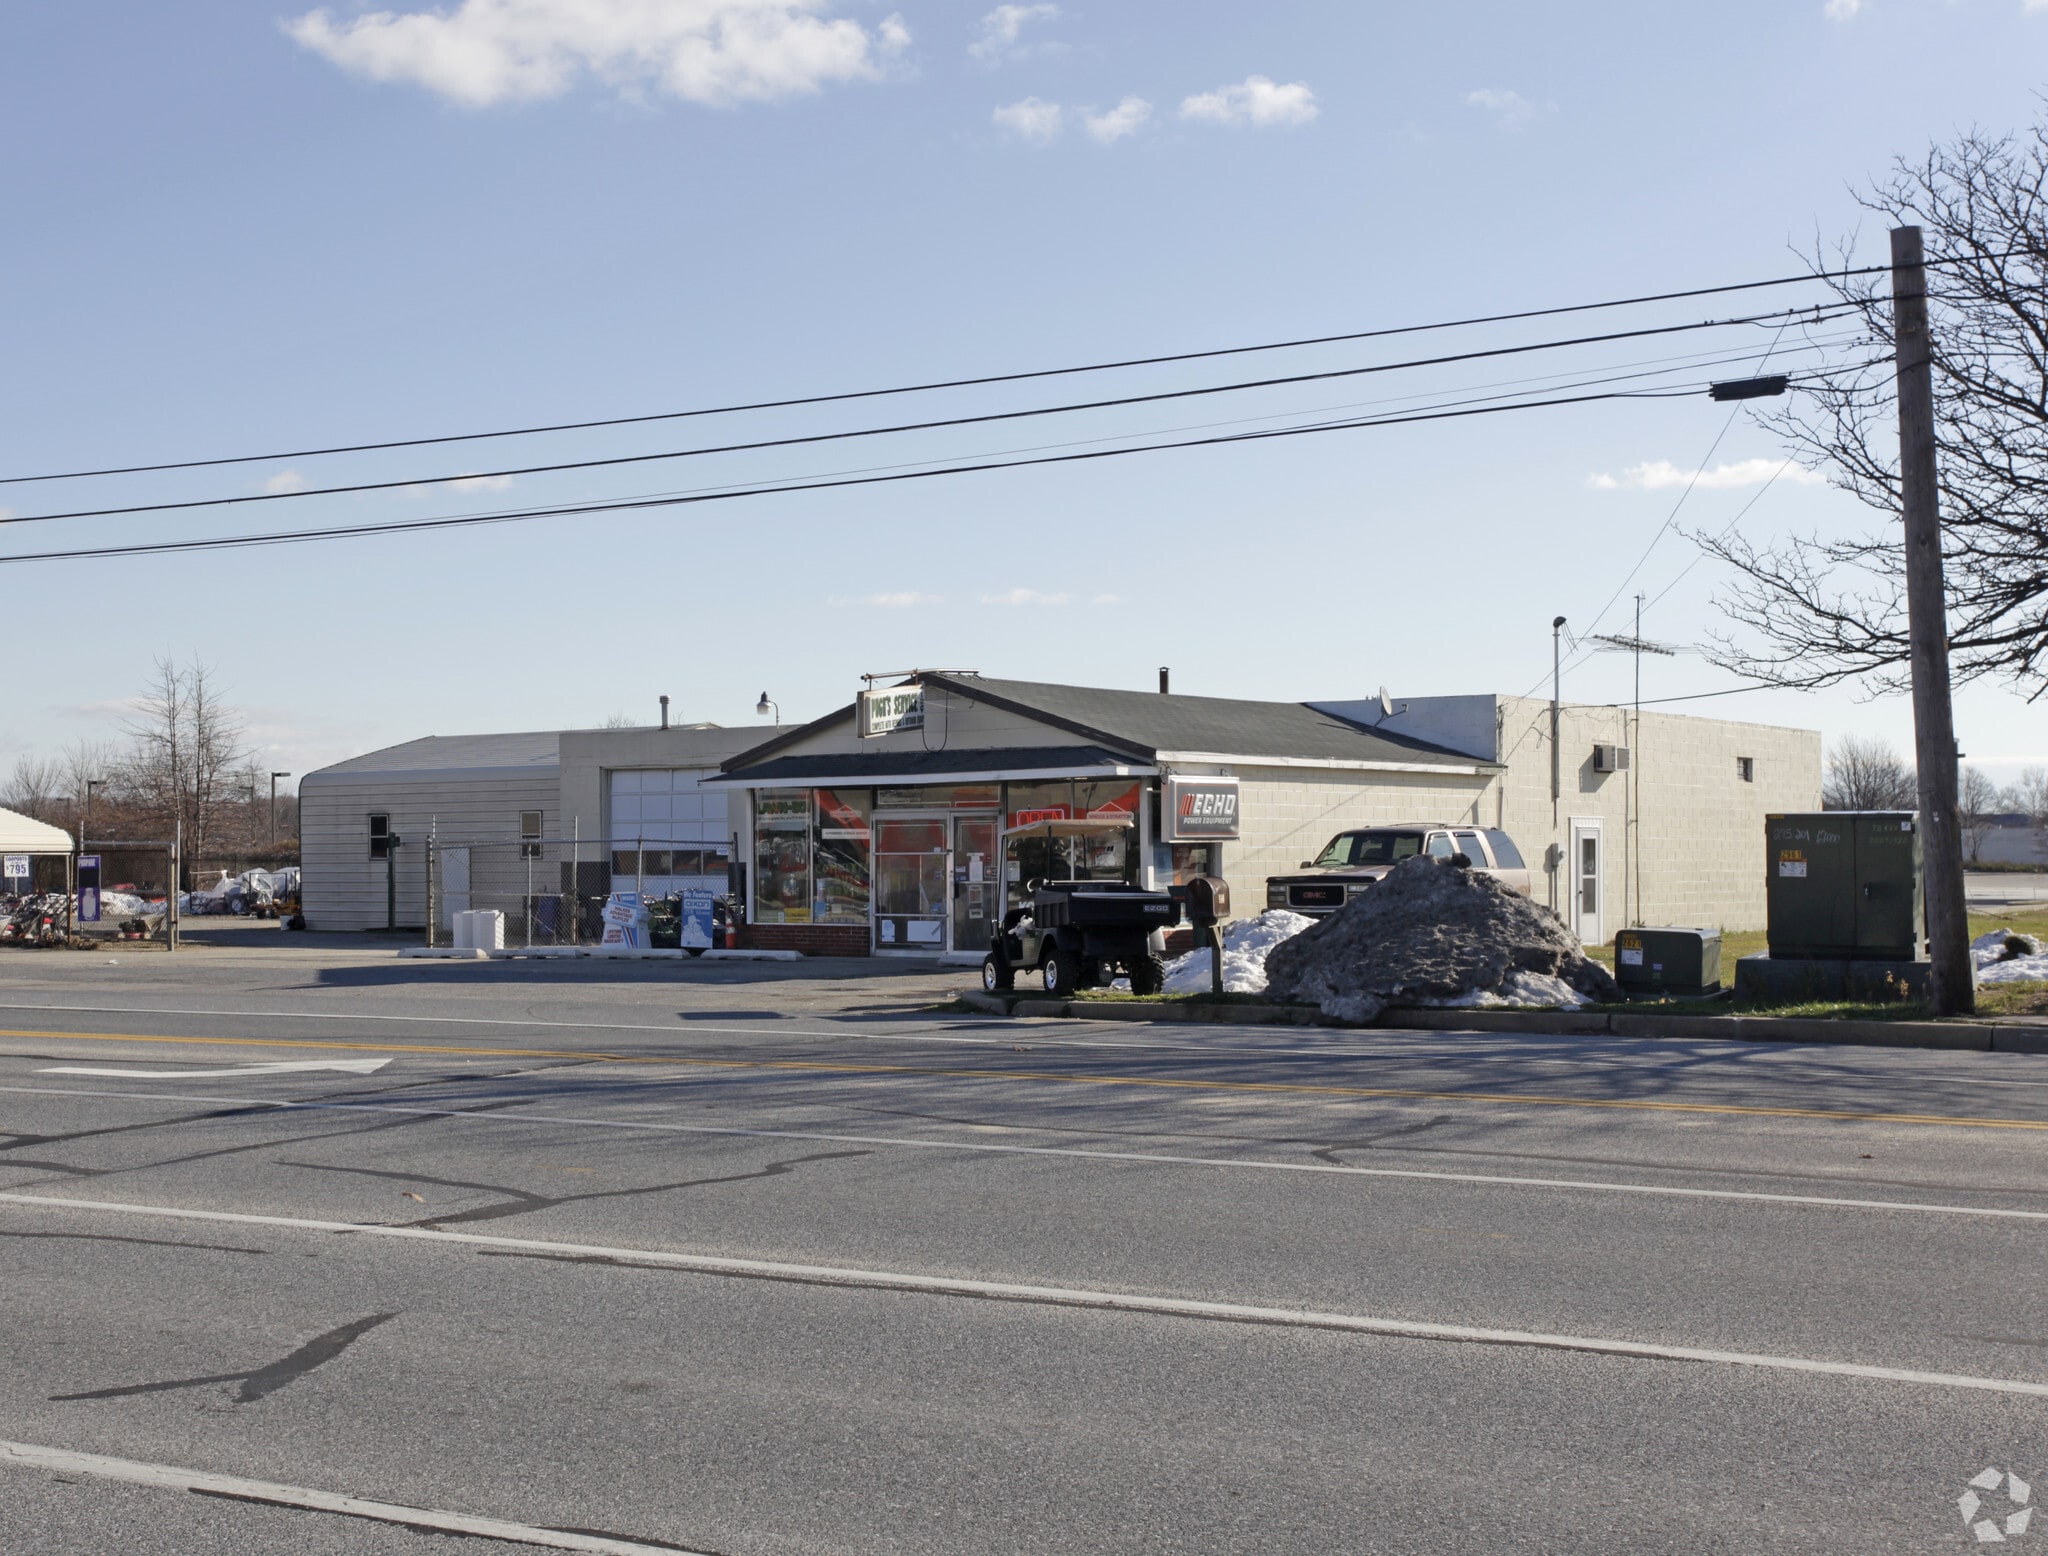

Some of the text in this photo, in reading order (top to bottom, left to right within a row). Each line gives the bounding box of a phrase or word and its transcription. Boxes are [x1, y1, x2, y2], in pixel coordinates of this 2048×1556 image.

[1193, 794, 1236, 814] ECHO
[1183, 817, 1232, 825] POWER EQUIPMENT
